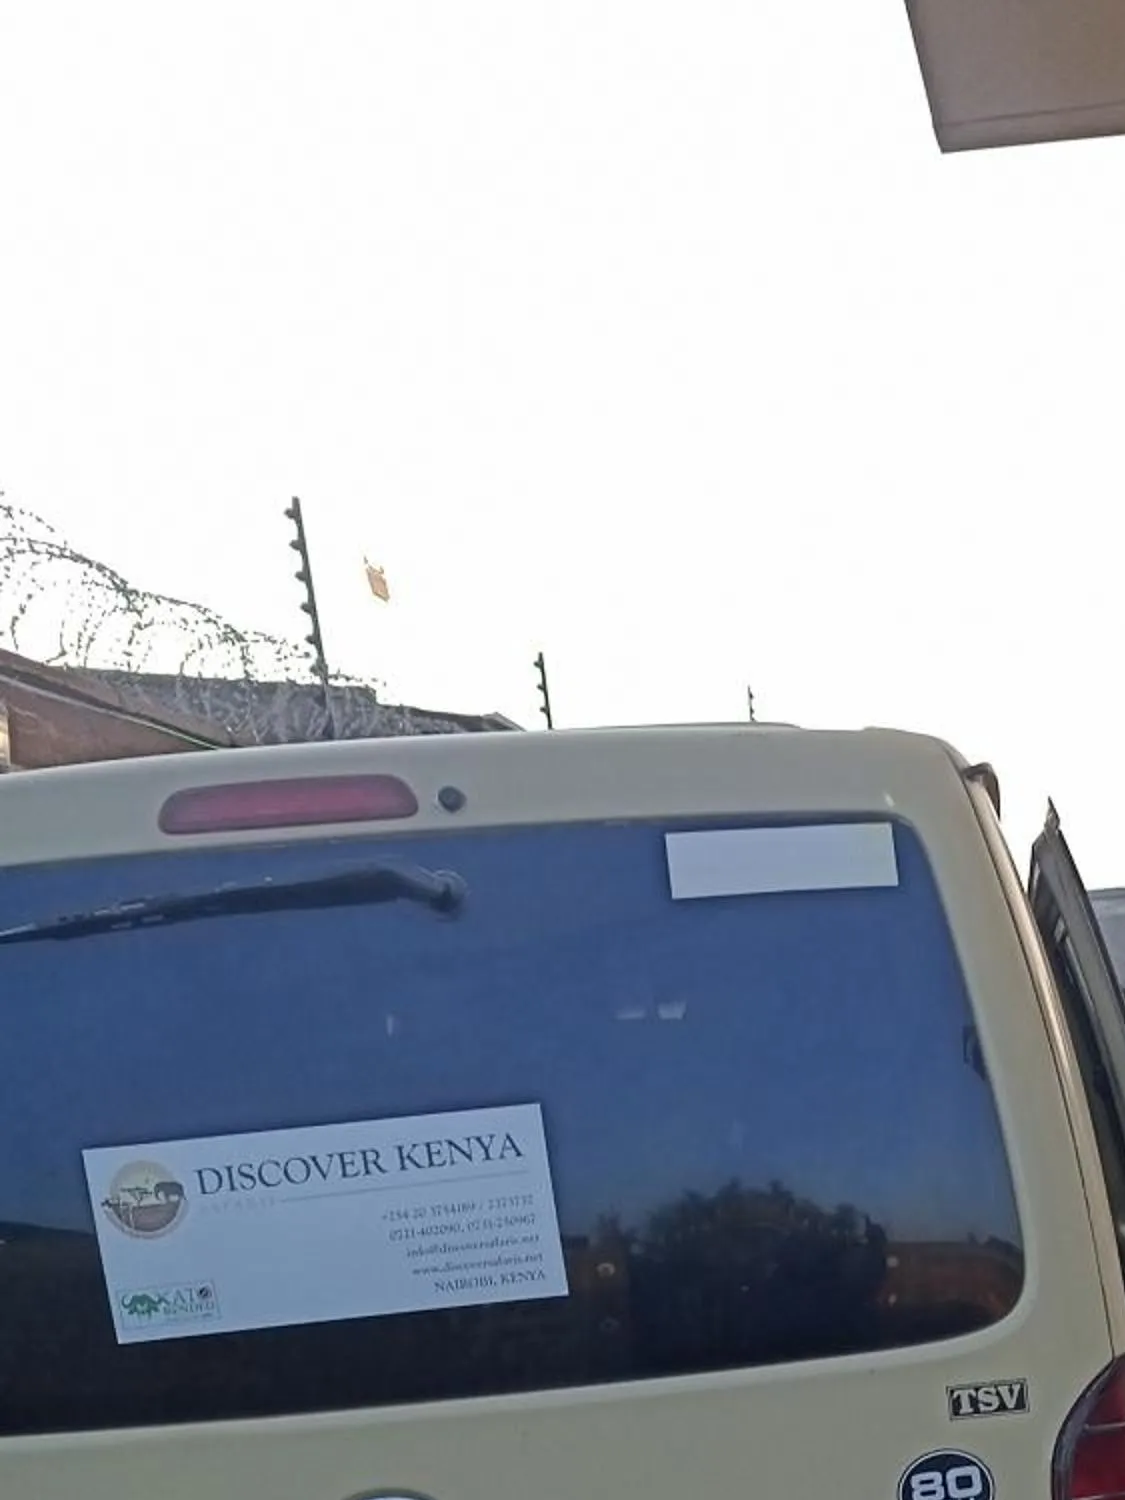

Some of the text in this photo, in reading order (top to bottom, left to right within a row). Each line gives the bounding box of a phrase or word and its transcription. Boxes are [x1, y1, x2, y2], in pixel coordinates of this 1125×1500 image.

[194, 1131, 524, 1196] DISCOVER KENYA
[500, 1268, 546, 1286] KENYA
[952, 1382, 1021, 1415] TSV
